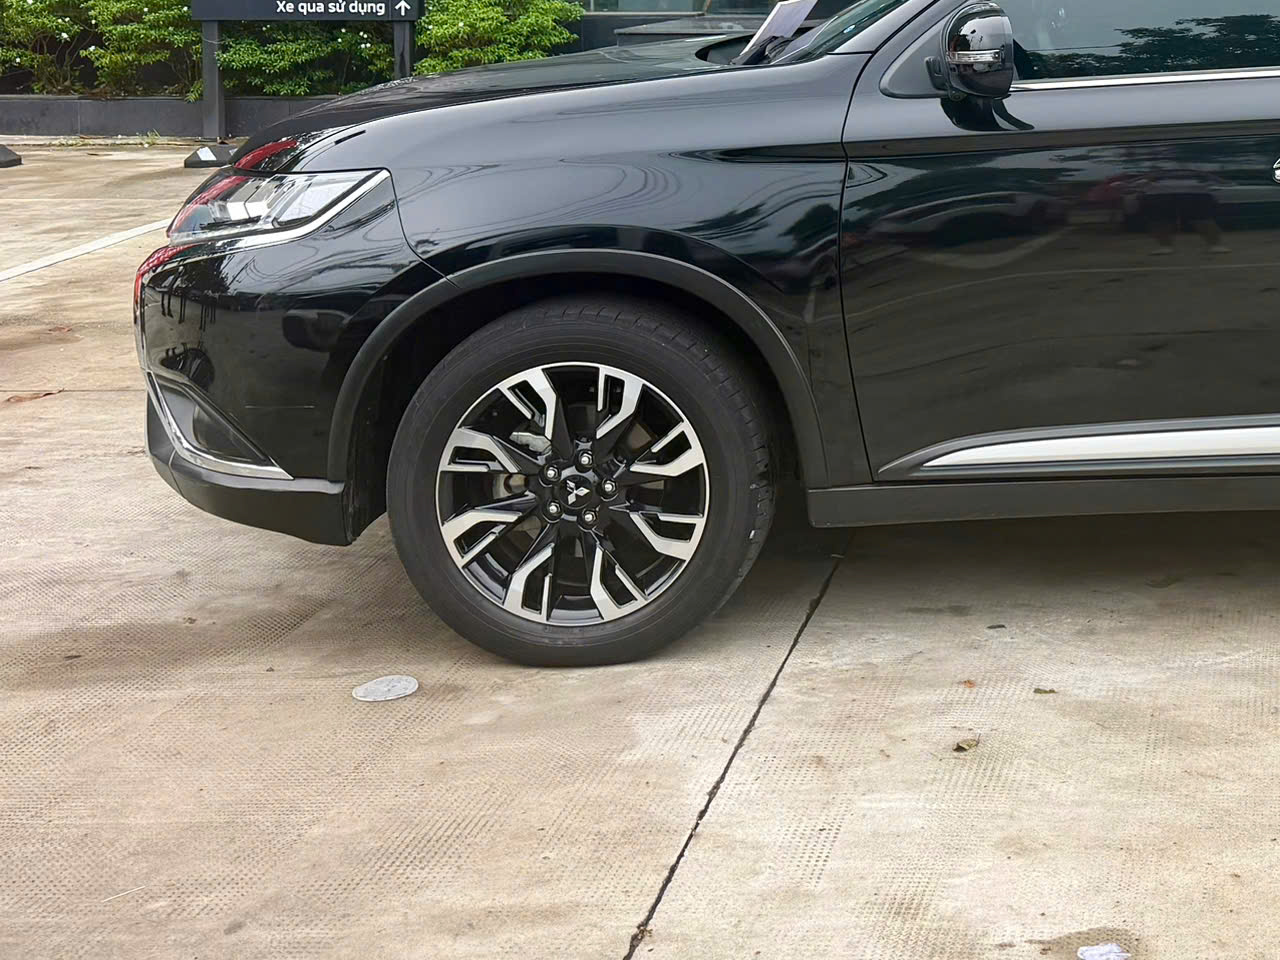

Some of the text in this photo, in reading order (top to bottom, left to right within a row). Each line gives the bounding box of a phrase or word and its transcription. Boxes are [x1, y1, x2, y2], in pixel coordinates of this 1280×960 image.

[276, 0, 386, 15] Xe qua sử dụng
